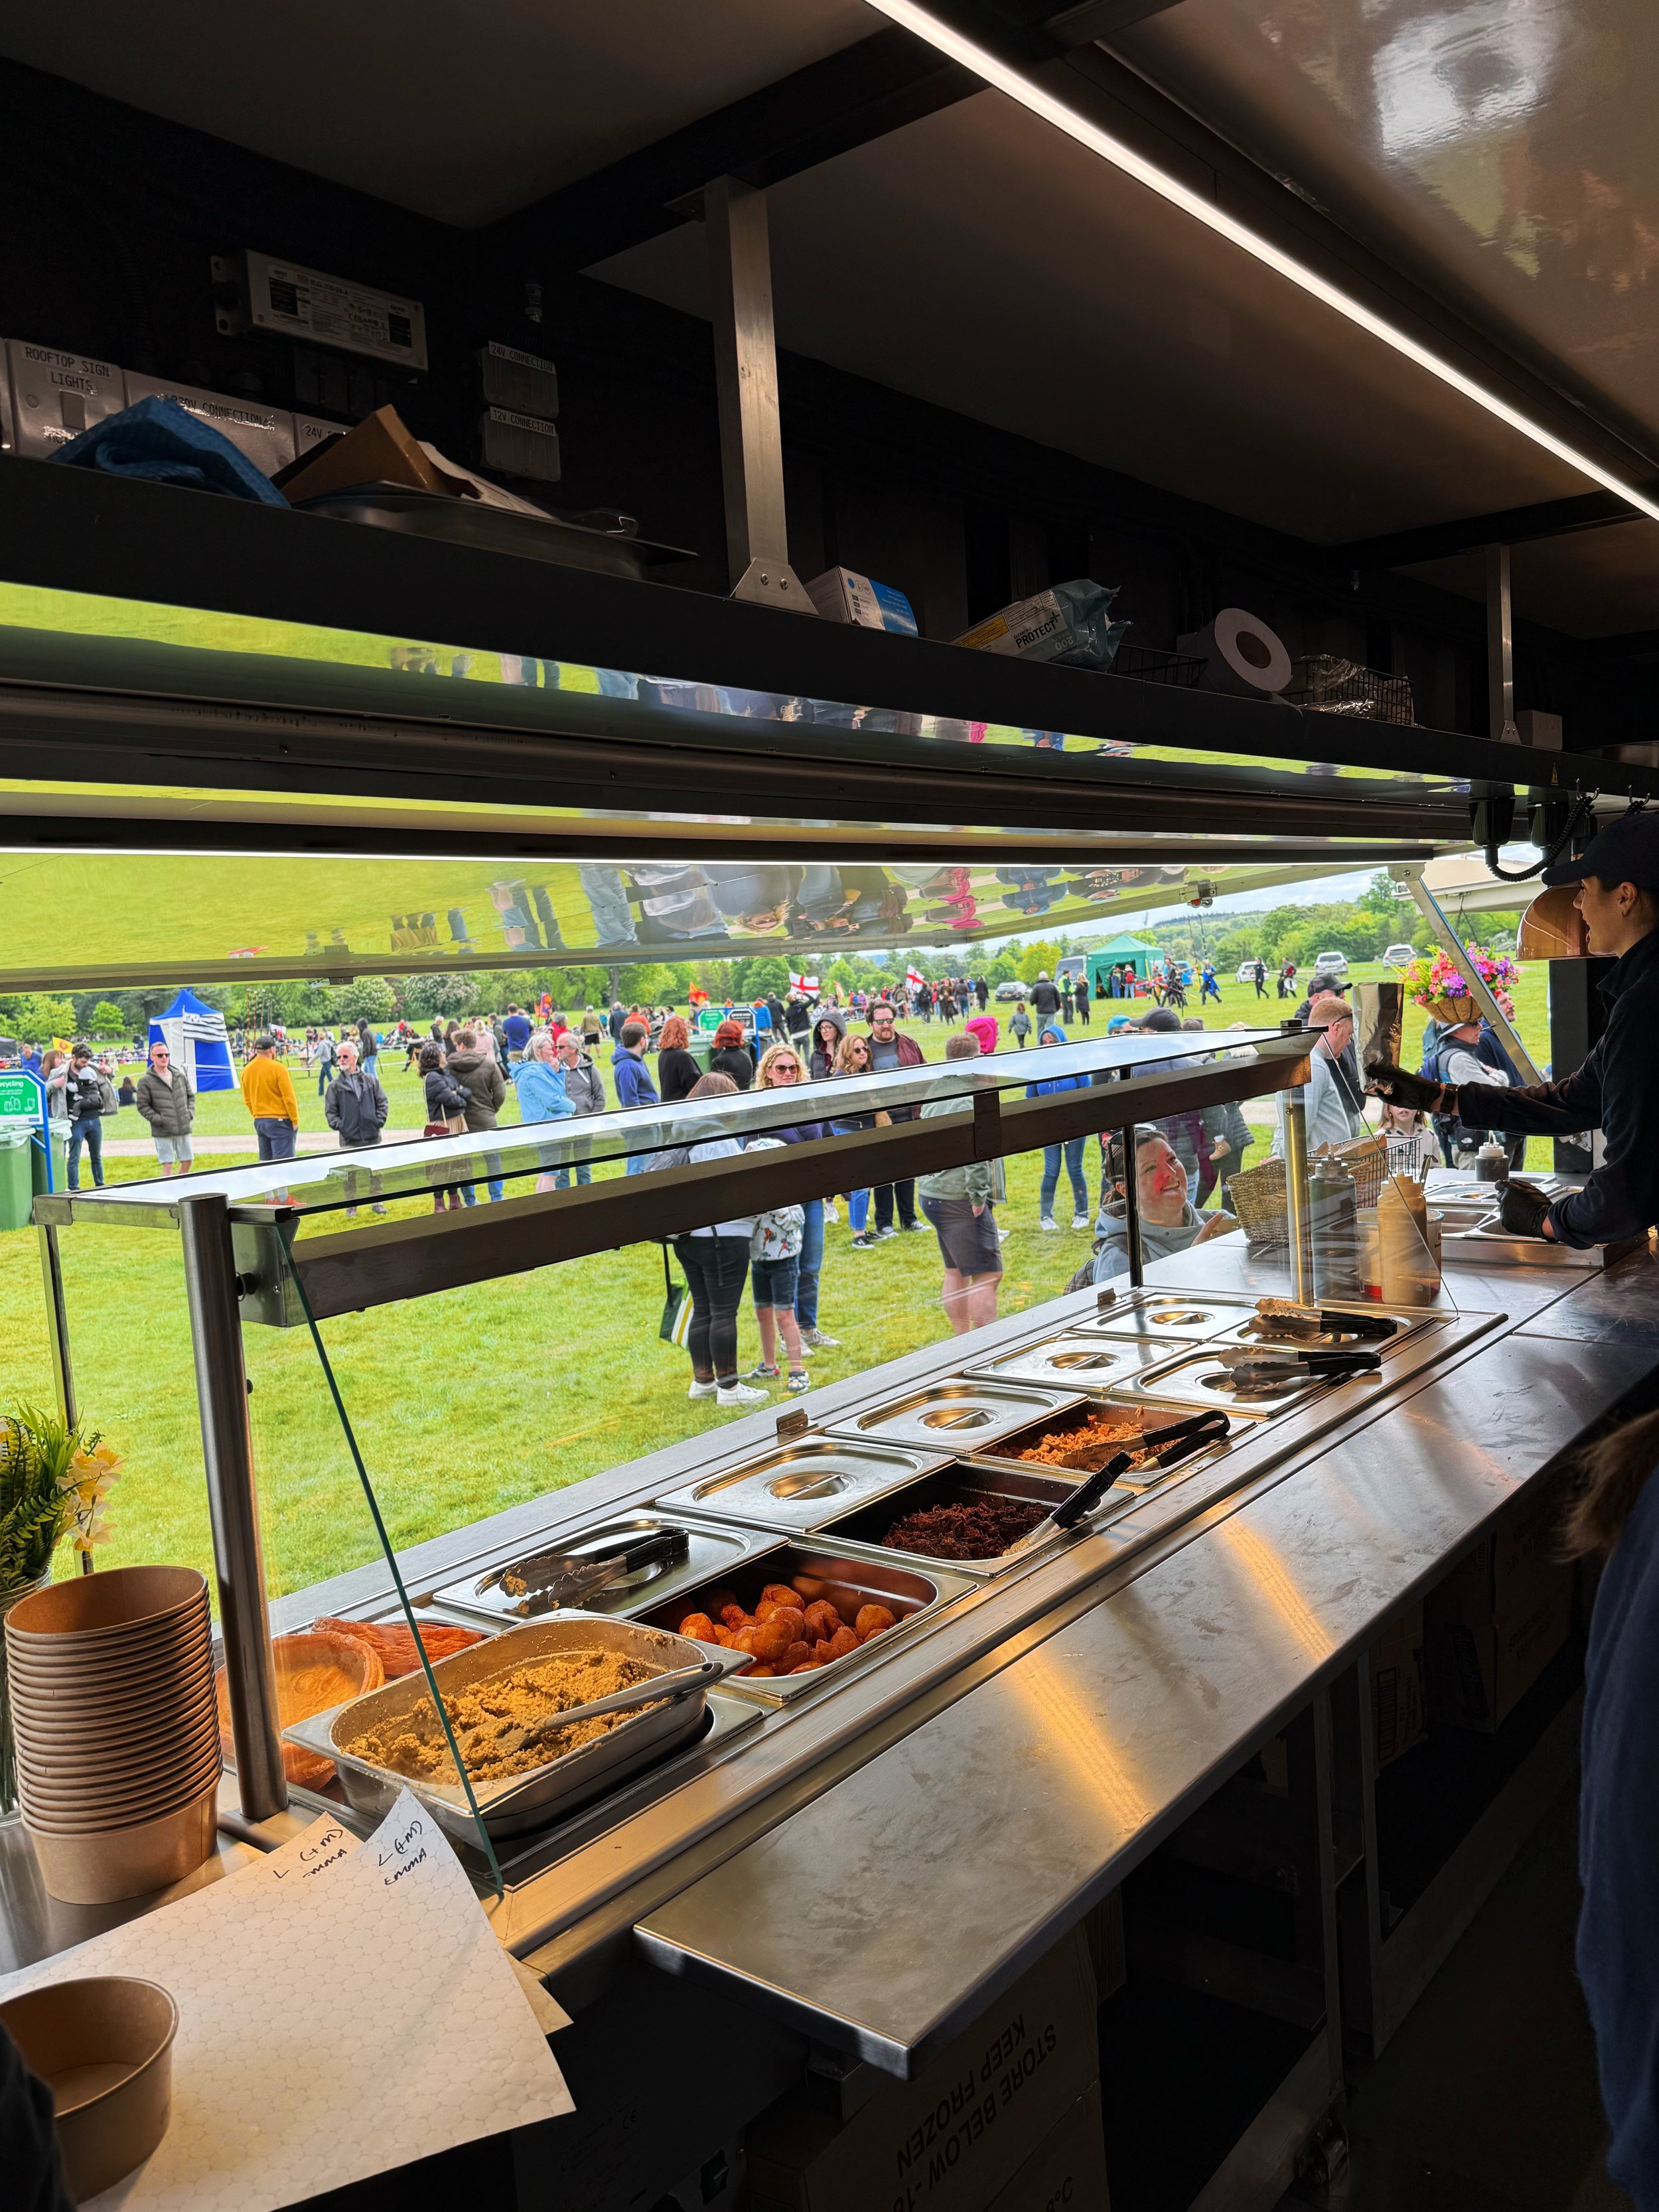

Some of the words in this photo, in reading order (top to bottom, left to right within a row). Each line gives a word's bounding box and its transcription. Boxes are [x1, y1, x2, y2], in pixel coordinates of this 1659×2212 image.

[25, 346, 75, 368] ROOFTOP
[82, 361, 109, 377] SIGN
[492, 344, 506, 356] 24V
[510, 350, 553, 372] CONNECTION
[51, 372, 93, 391] LIGHTS
[305, 425, 323, 438] 24V
[493, 409, 506, 421] 12V
[511, 415, 554, 434] CONNECTION
[1054, 636, 1074, 650] 200
[981, 2014, 1026, 2083] KEEP
[1000, 2024, 1057, 2106] STORE
[897, 2070, 976, 2178] FROZEN
[929, 2091, 997, 2191] BELOW
